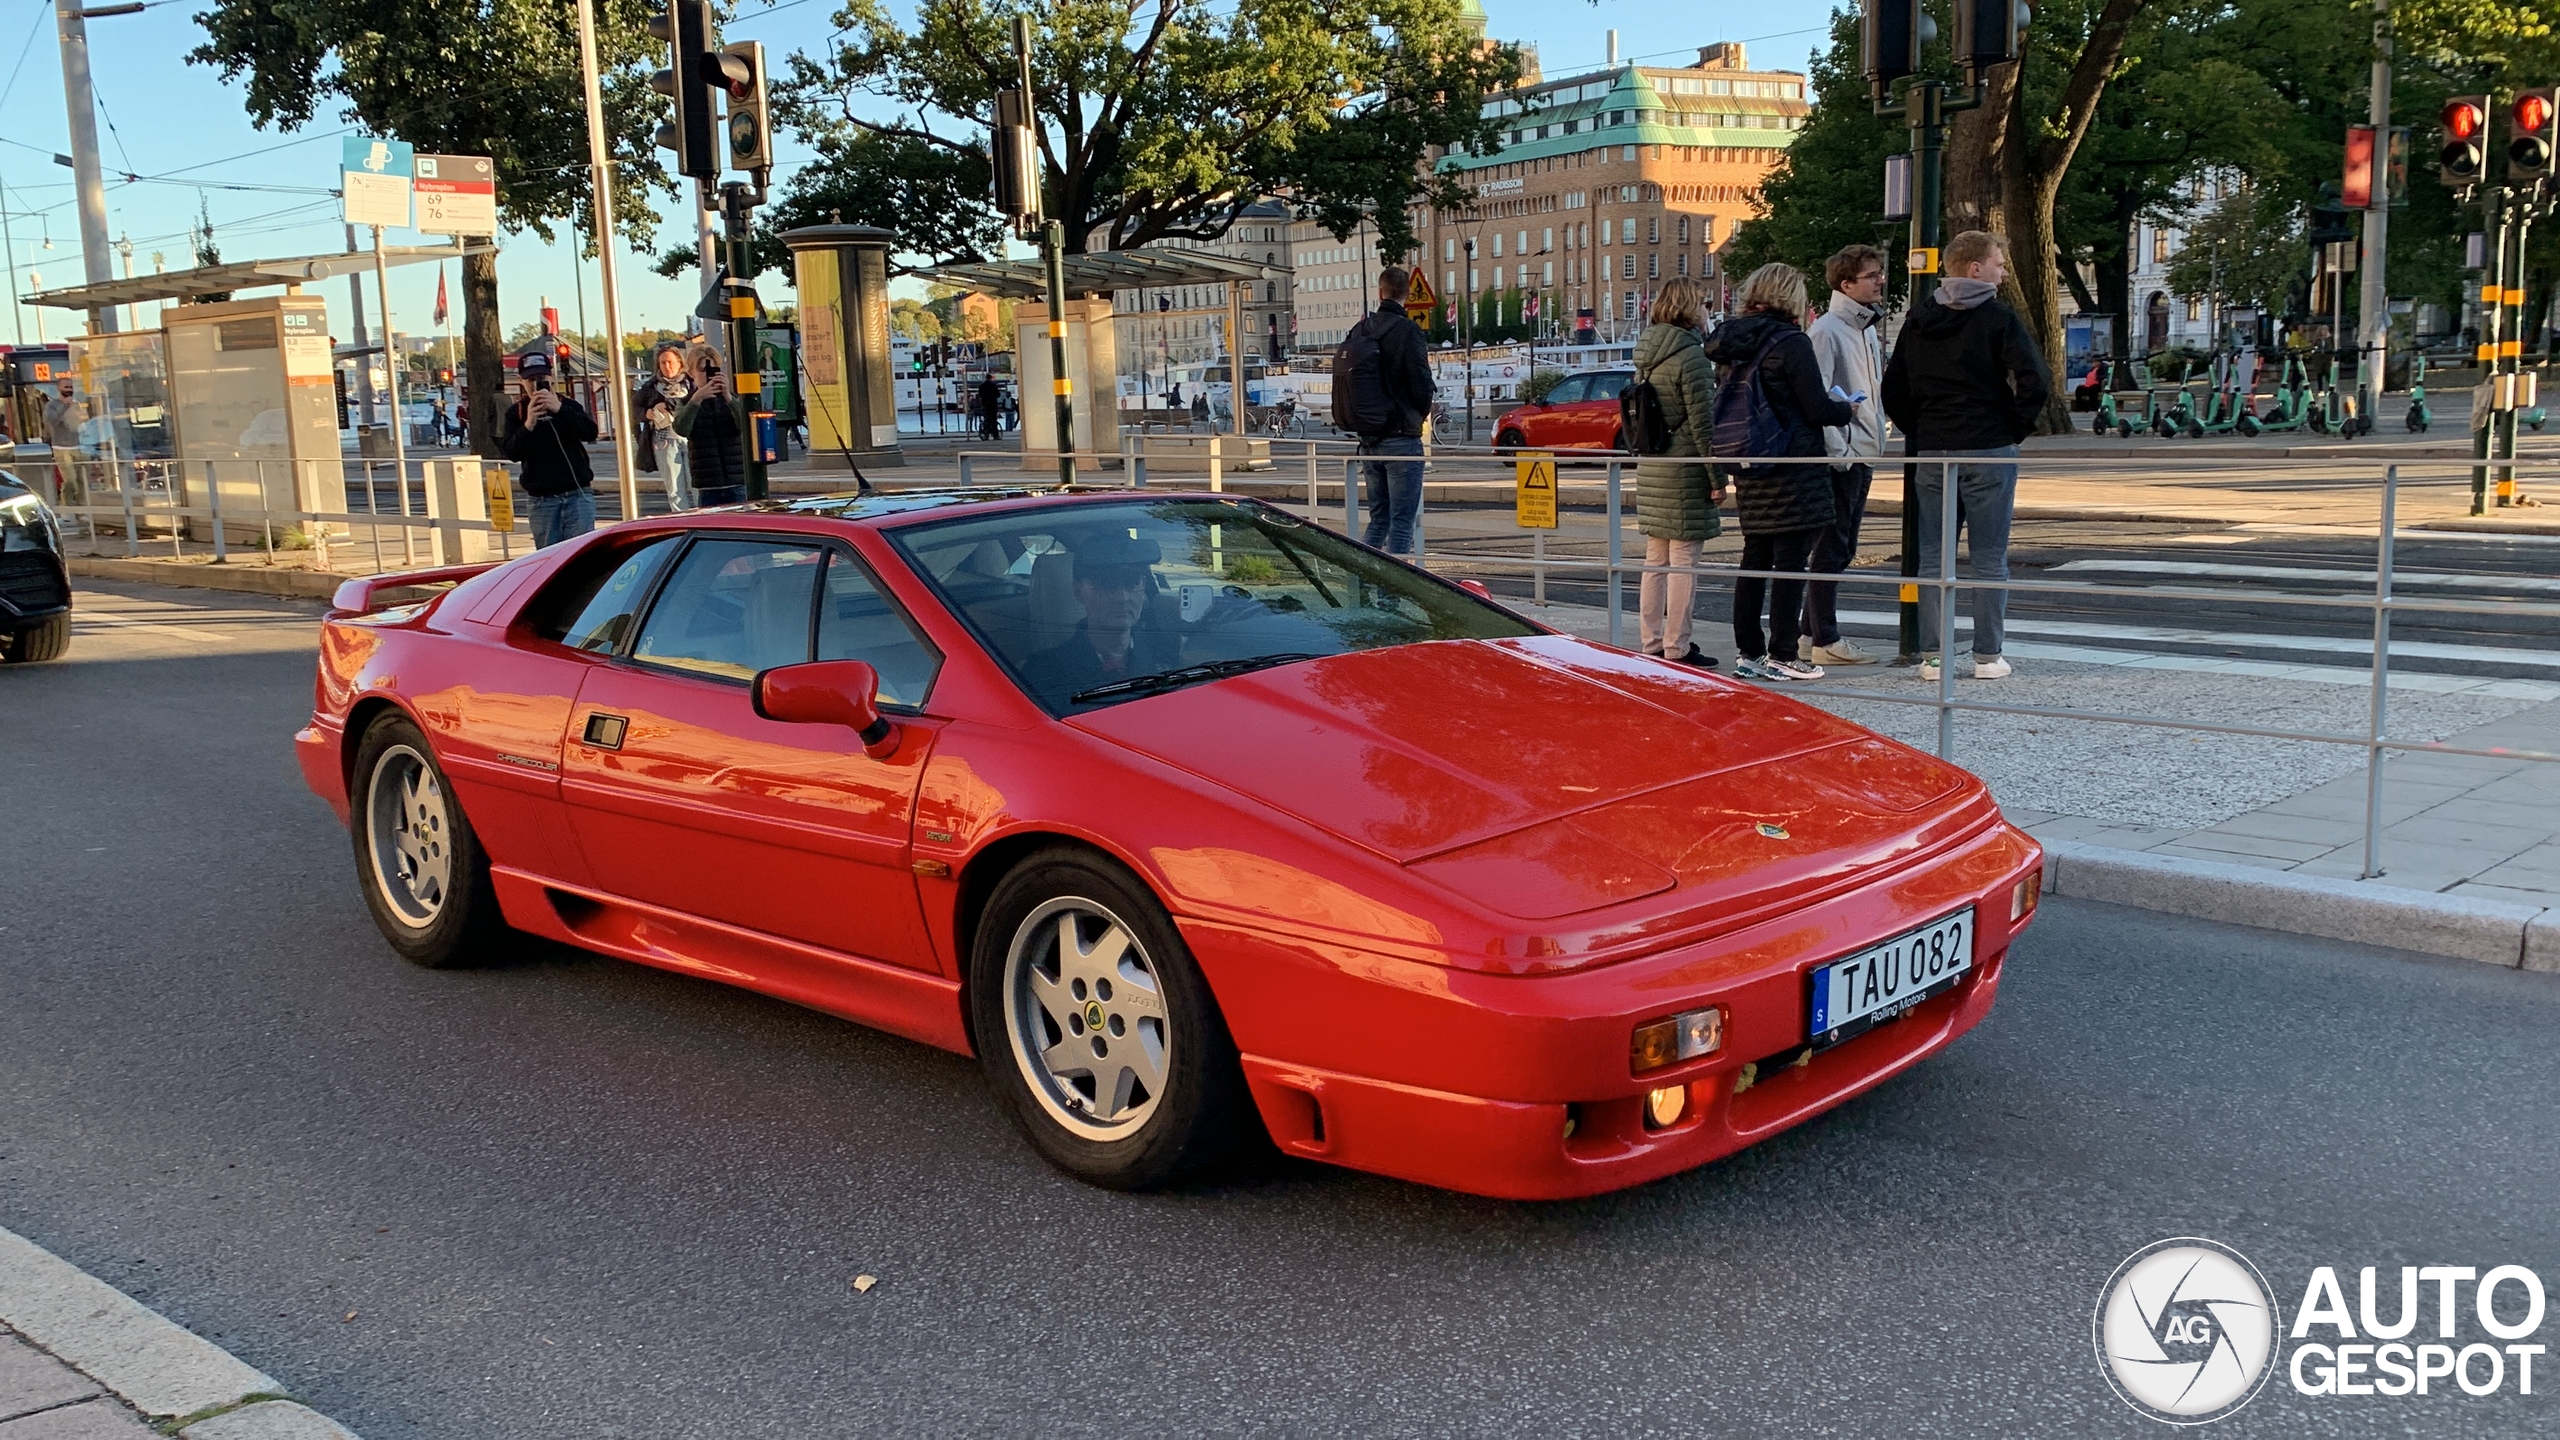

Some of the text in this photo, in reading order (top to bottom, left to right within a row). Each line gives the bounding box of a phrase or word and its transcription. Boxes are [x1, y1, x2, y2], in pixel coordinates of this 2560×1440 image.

[418, 182, 457, 193] Nybroplan
[1491, 178, 1524, 190] RADISSON
[1491, 188, 1524, 197] COLLECTION
[427, 194, 443, 205] 69
[427, 208, 443, 219] 76
[284, 327, 316, 336] Nybroplan
[34, 363, 51, 381] 69
[1843, 922, 1962, 1014] TAU 082
[1127, 993, 1161, 1010] LOTU
[1870, 991, 1927, 1024] Rolling Motors
[1816, 1009, 1823, 1022] S
